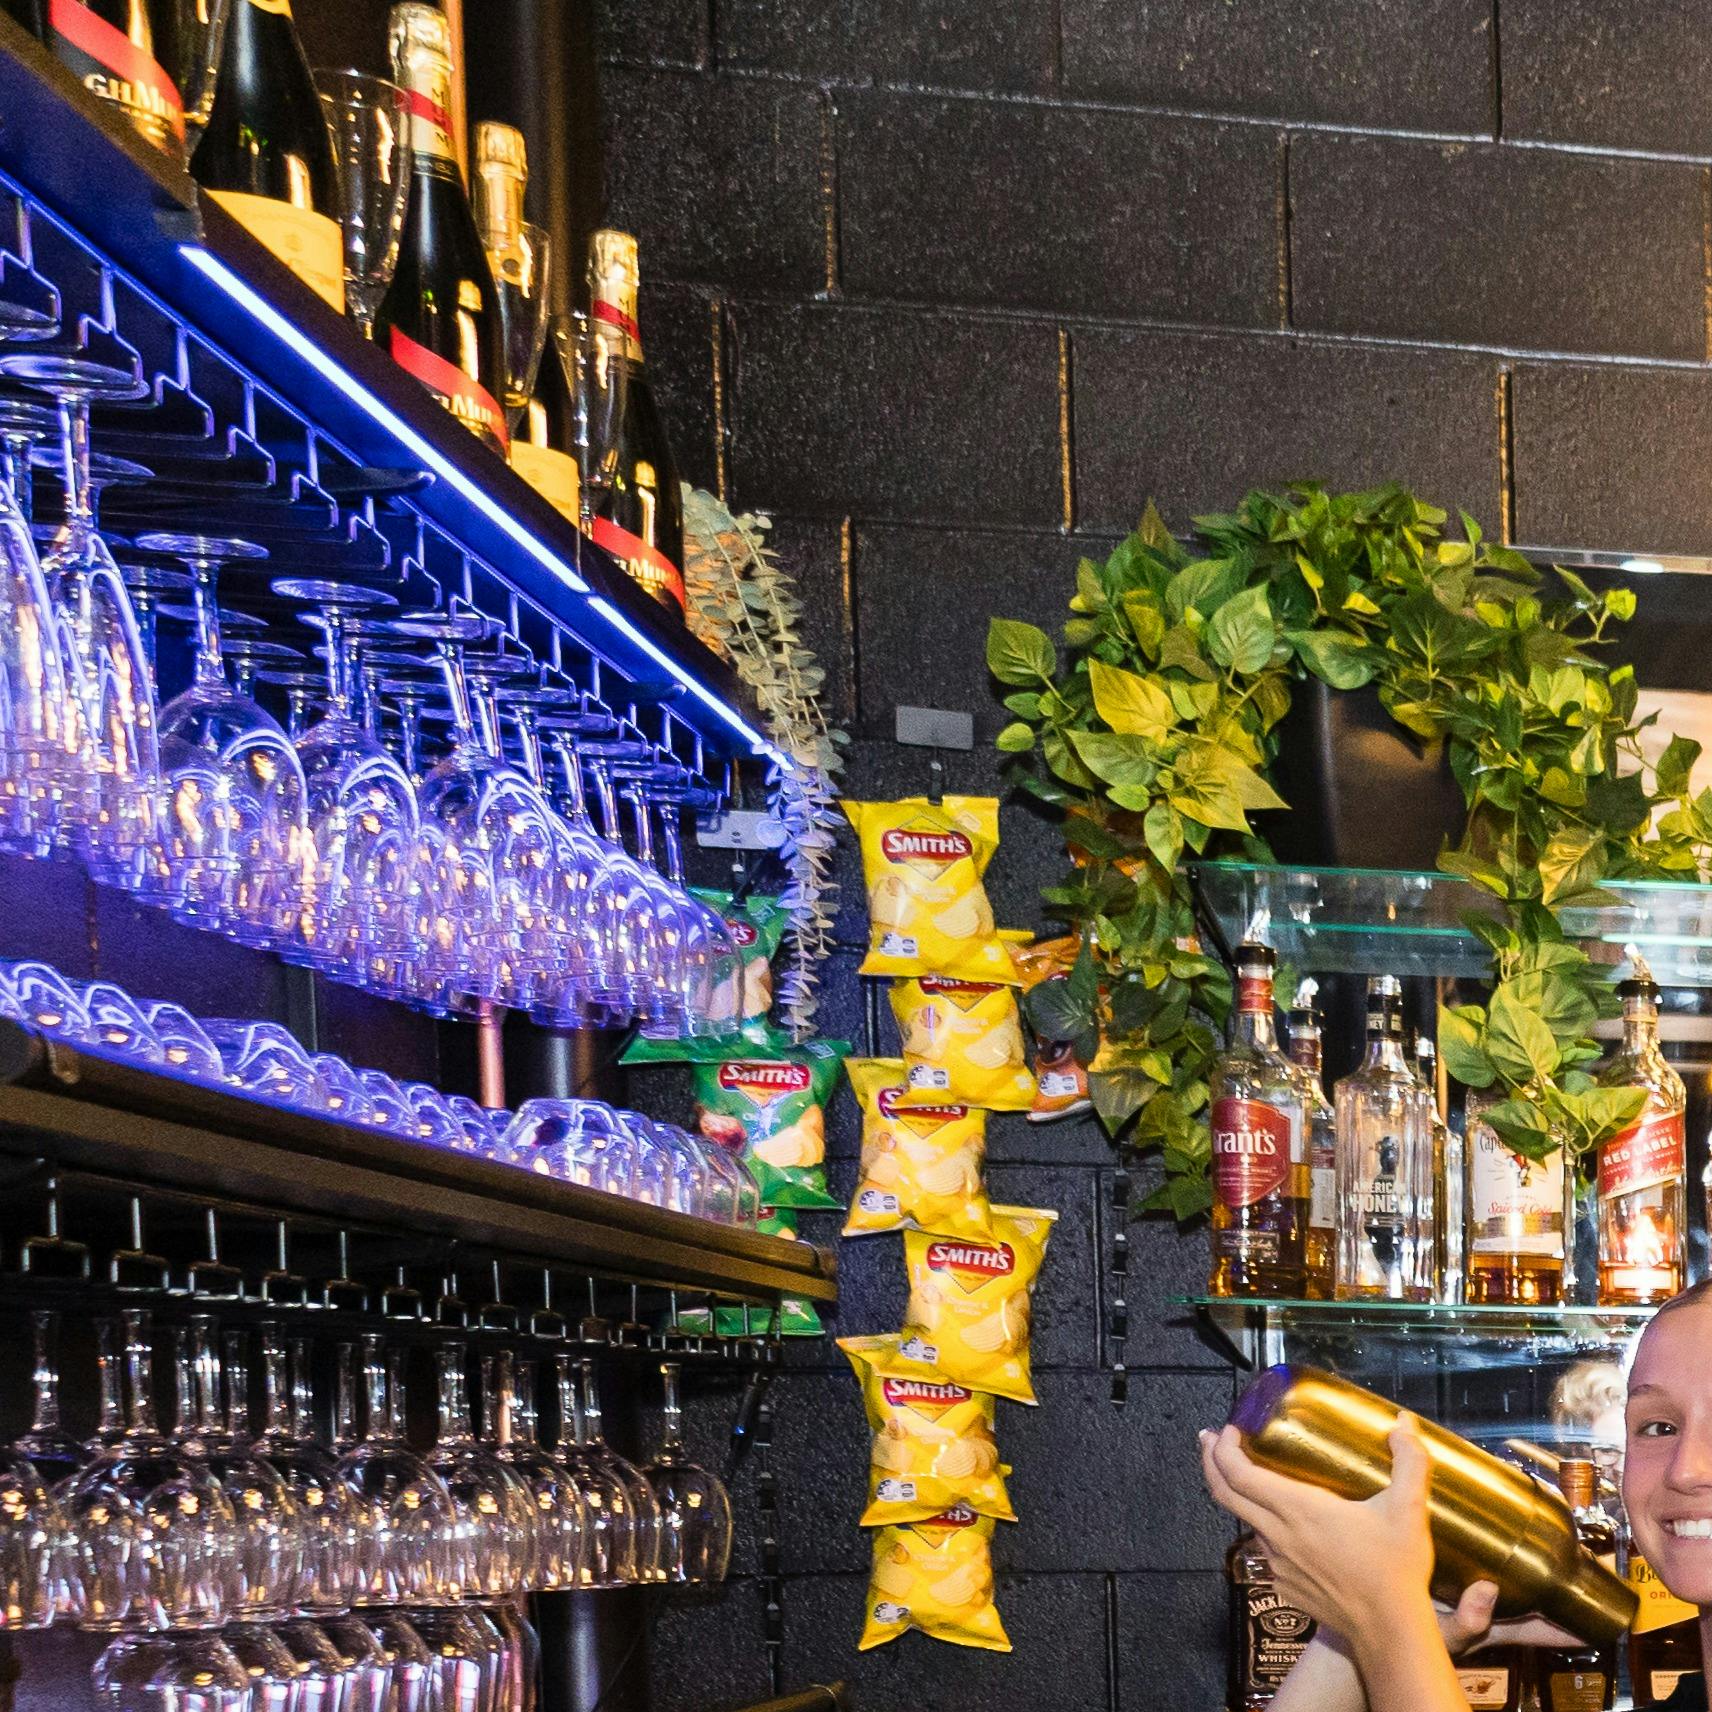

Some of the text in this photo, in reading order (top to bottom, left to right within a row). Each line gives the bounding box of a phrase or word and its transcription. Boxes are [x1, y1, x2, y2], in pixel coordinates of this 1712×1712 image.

[886, 832, 968, 856] SMITH'S
[722, 1064, 807, 1086] SMITH'S
[1217, 1129, 1276, 1156] rant's
[1603, 1150, 1631, 1167] RED
[1635, 1136, 1678, 1157] LABEL
[928, 1244, 1013, 1271] SMITH'S
[1258, 1654, 1299, 1663] WHISK
